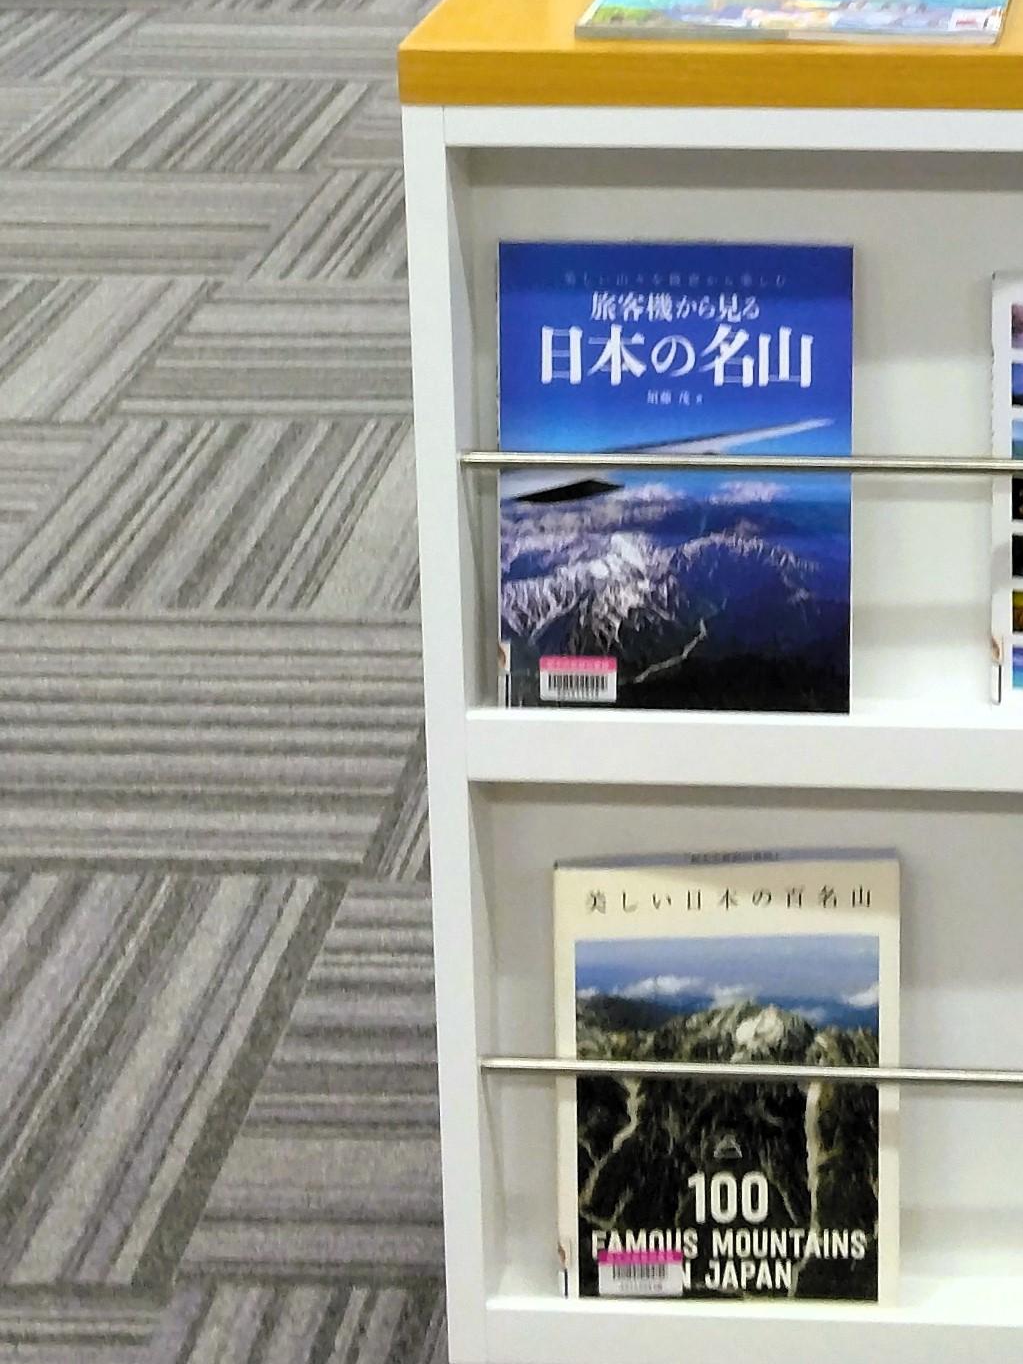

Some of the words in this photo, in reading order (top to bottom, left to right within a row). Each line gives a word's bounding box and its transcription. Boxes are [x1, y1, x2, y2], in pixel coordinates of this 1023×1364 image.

[590, 290, 761, 323] 旅客機から見る
[540, 323, 814, 388] 日本の名山
[586, 884, 872, 915] 美しい日本の百名山
[688, 1171, 769, 1224] 100
[591, 1228, 698, 1261] FAMOUS
[712, 1228, 868, 1260] MOUNTAINS
[704, 1259, 793, 1291] JAPAN
